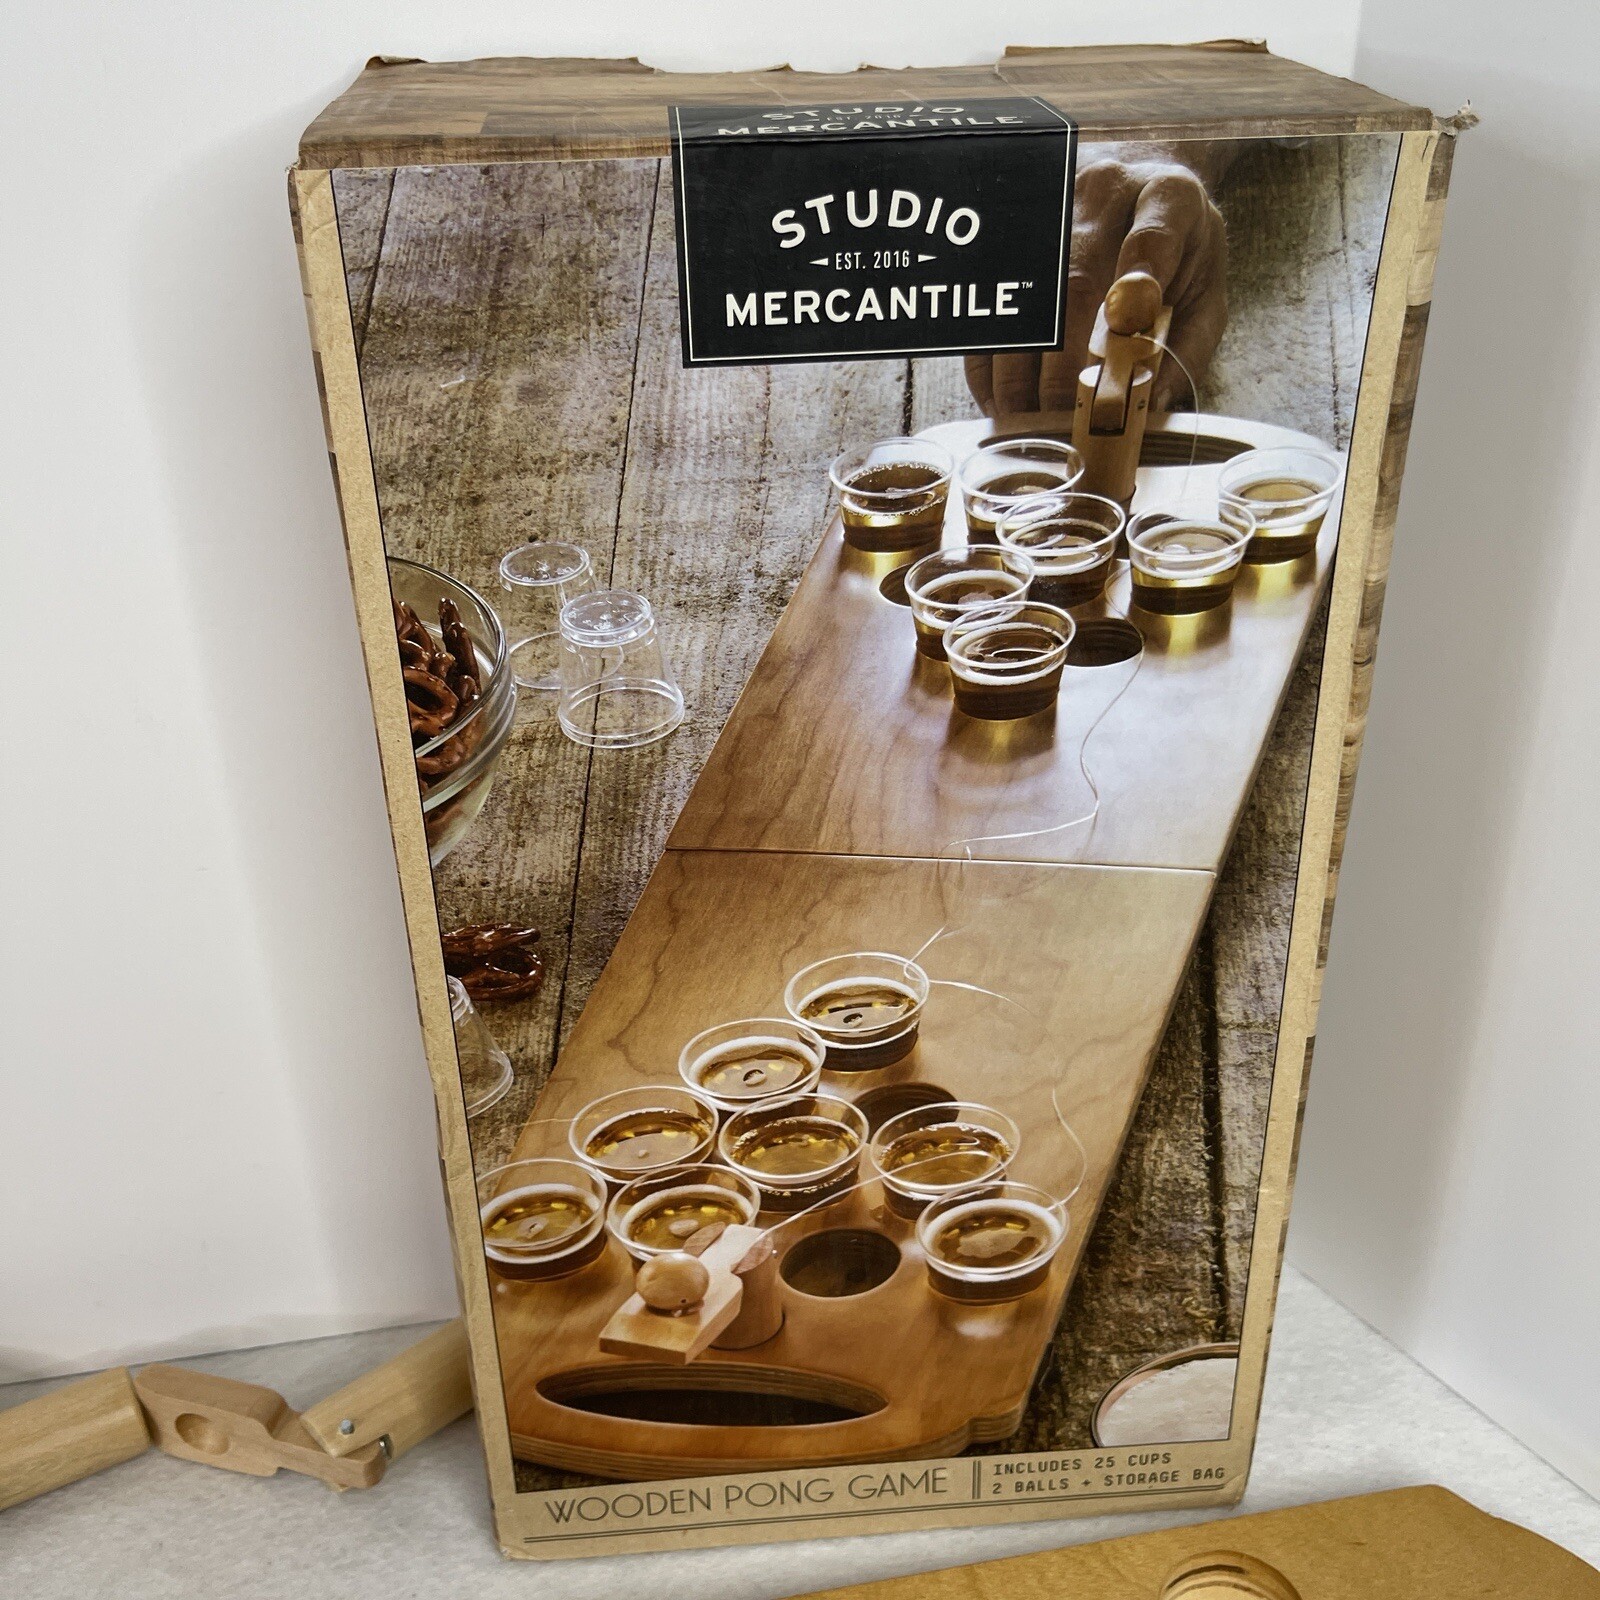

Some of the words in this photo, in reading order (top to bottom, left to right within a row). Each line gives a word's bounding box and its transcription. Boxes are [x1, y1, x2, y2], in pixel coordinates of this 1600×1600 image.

[762, 106, 965, 121] STUDIO
[771, 189, 981, 249] STUDIO
[835, 252, 867, 271] EST.
[873, 249, 910, 270] 2016
[993, 1458, 1082, 1476] INCLUDES
[1094, 1455, 1116, 1469] 25
[1128, 1452, 1172, 1467] CUPS
[992, 1482, 1003, 1495] 2
[1014, 1478, 1070, 1493] BALLS
[1104, 1470, 1181, 1487] STORAGE
[1192, 1467, 1226, 1480] BAG
[544, 1486, 712, 1524] WOODEN
[724, 1477, 835, 1510] PONG
[848, 1467, 948, 1500] GAME
